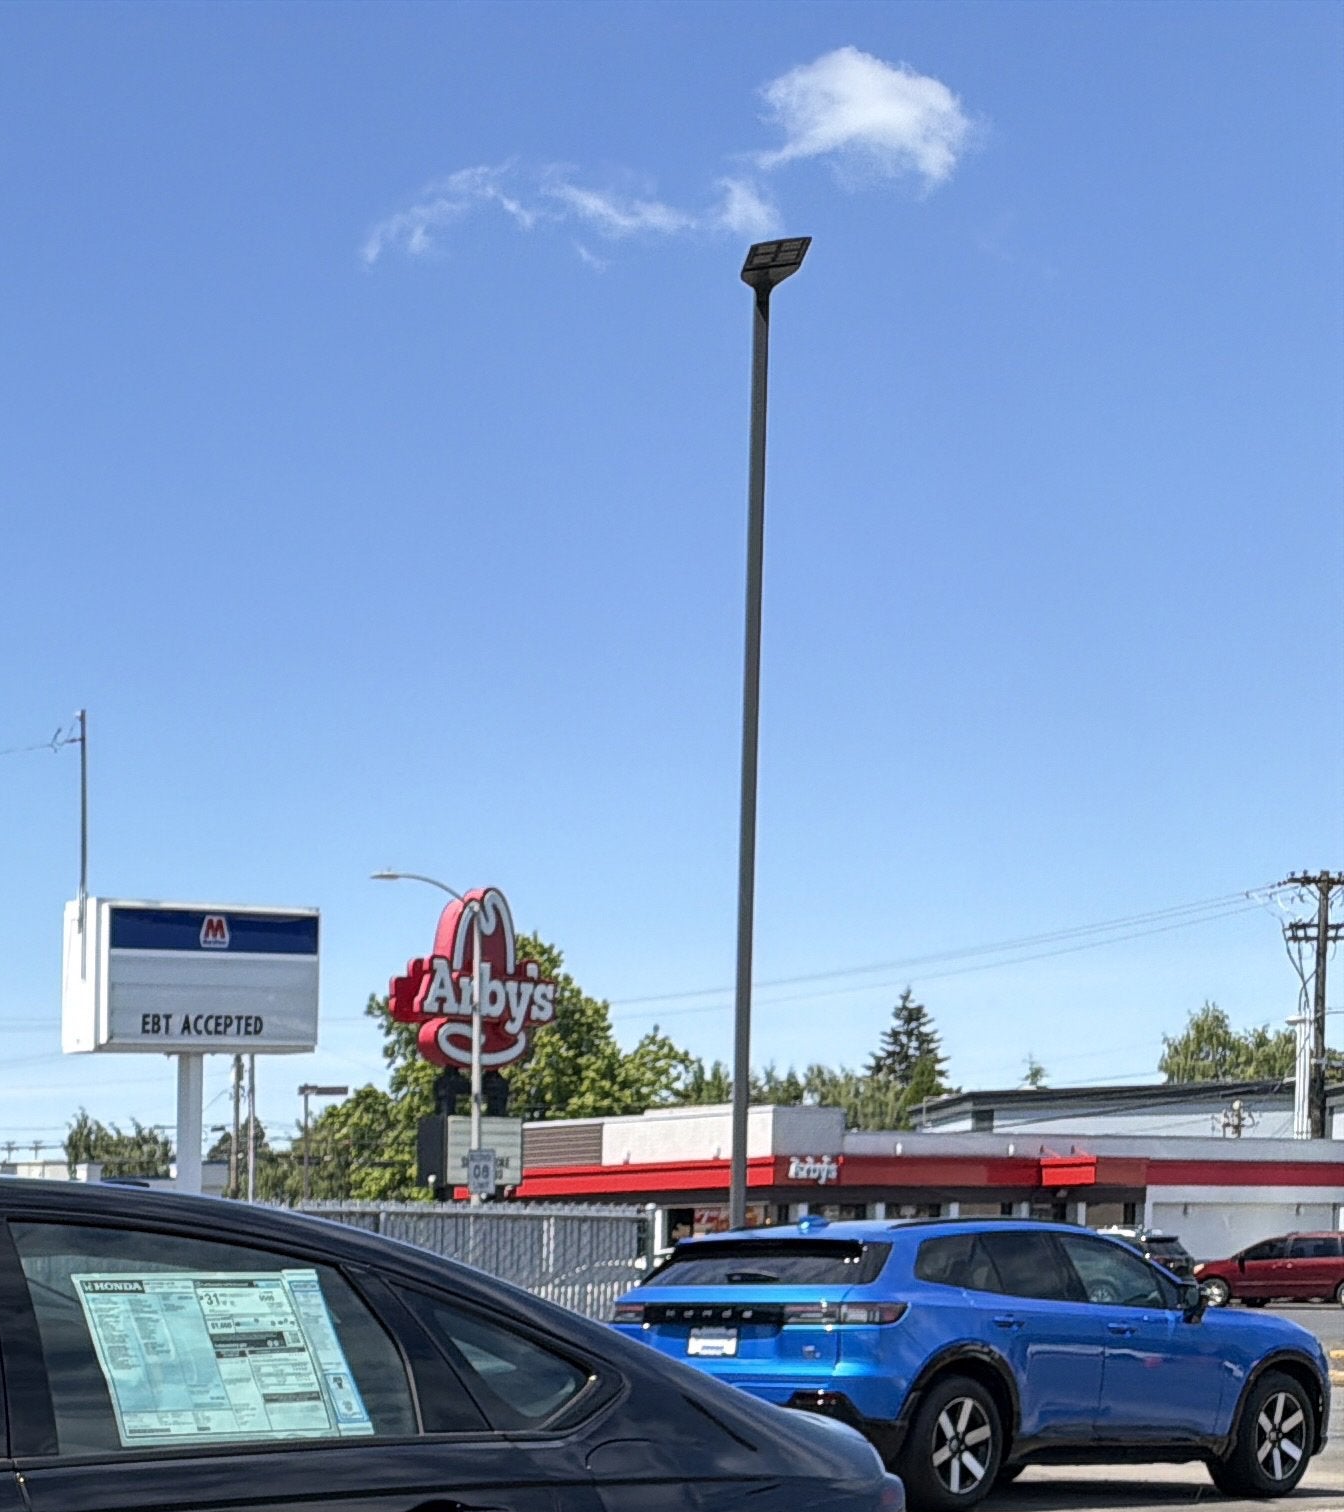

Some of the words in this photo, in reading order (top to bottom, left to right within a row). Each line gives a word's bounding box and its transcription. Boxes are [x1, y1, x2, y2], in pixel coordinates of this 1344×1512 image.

[423, 957, 555, 1035] Arby's
[140, 1013, 172, 1035] EBT
[180, 1013, 263, 1036] ACCEPTED
[94, 1281, 144, 1292] HONDA
[204, 1293, 221, 1306] 31
